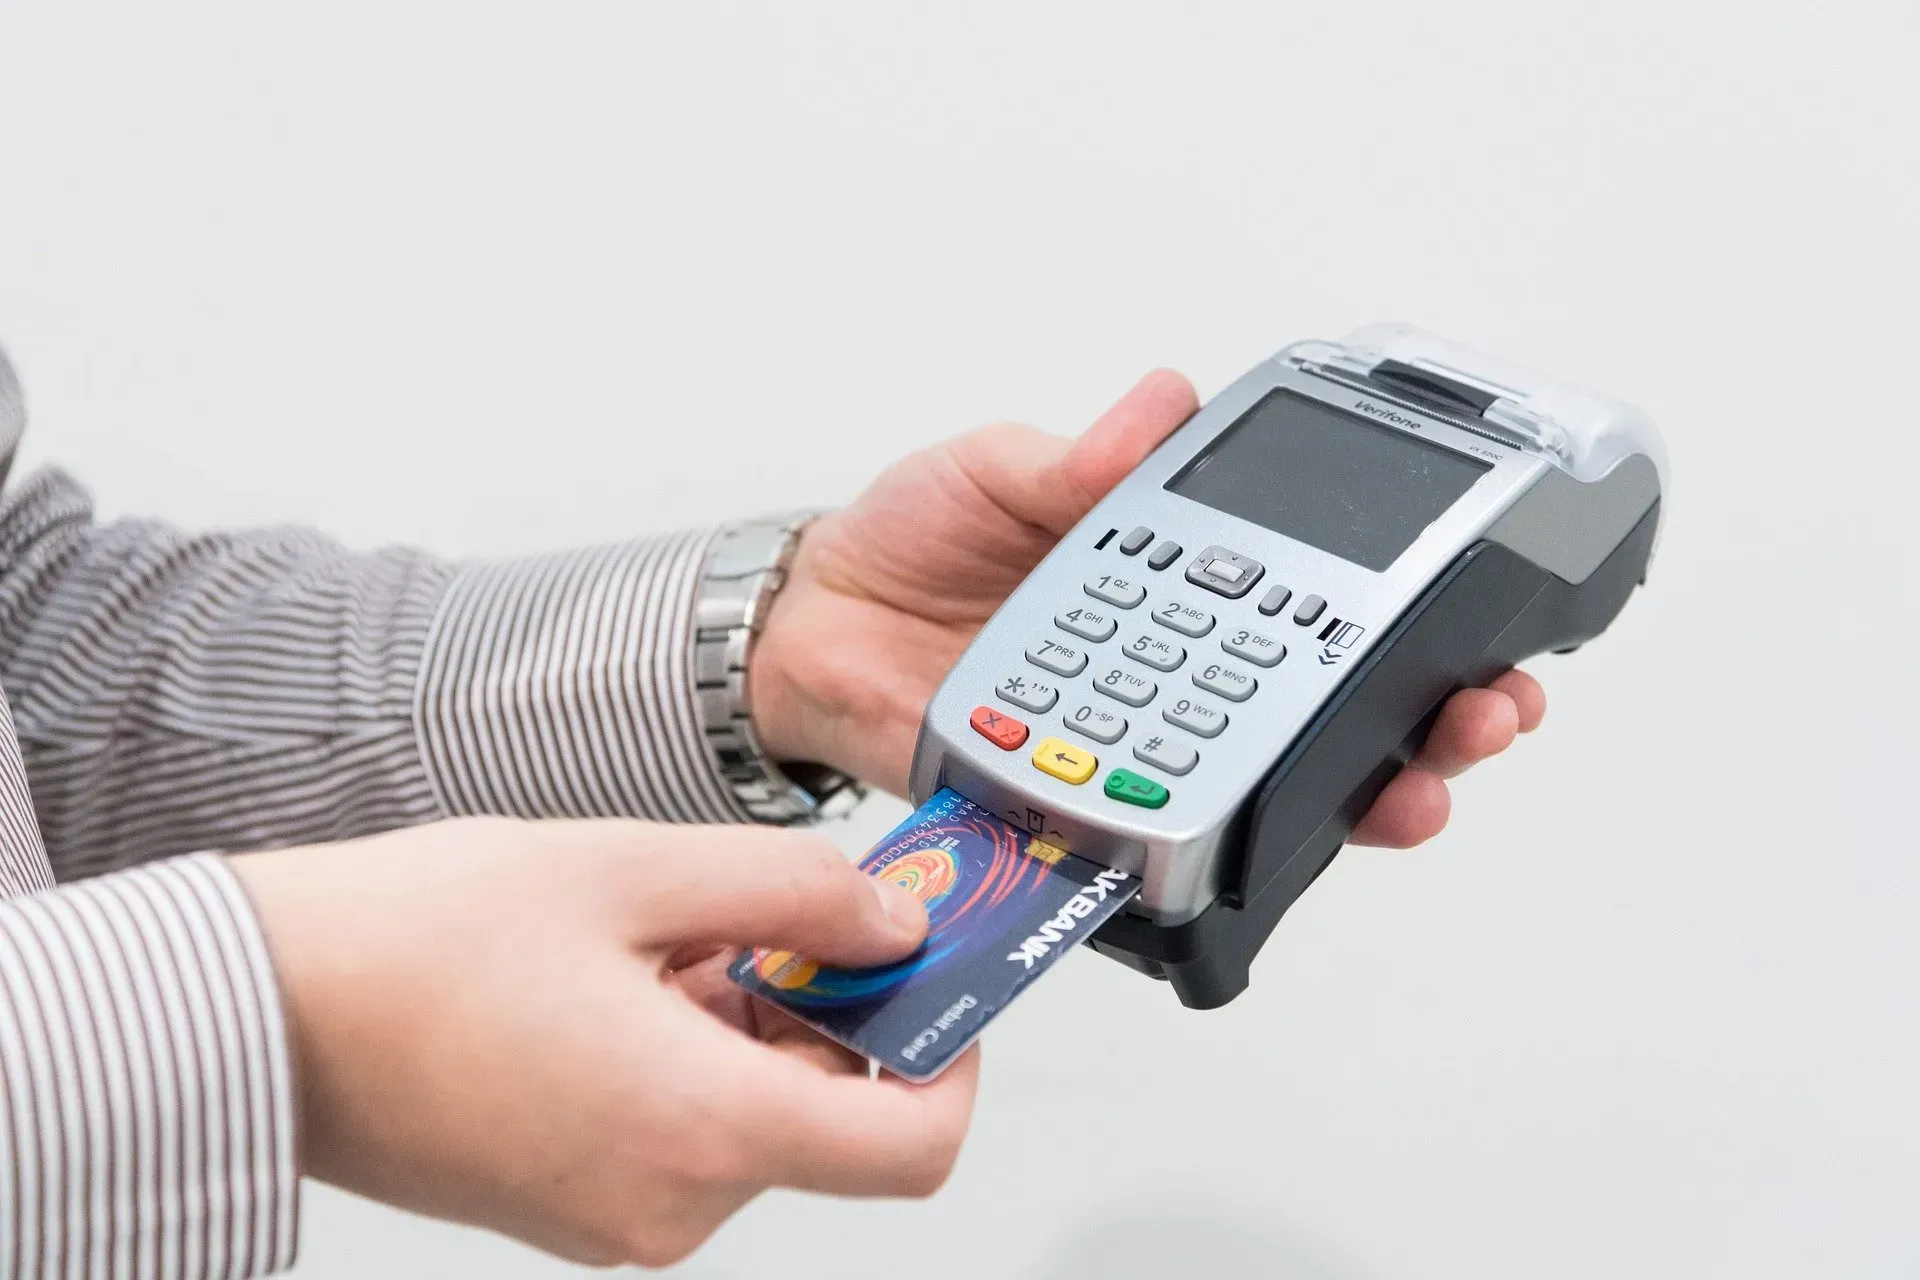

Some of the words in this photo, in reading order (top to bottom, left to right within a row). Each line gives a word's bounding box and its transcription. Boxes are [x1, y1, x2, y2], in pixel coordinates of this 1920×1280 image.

[1354, 400, 1422, 430] Verifone
[1098, 575, 1112, 589] 1
[1065, 608, 1083, 623] 4
[1084, 612, 1104, 624] GHI
[1161, 602, 1181, 618] 2
[1181, 607, 1204, 620] ABC
[1132, 635, 1152, 651] 5
[1152, 641, 1171, 653] JKL
[1231, 630, 1250, 646] 3
[1252, 636, 1274, 648] DEF
[1037, 639, 1056, 655] 7
[1054, 645, 1075, 659] PRS
[1104, 669, 1123, 685] 8
[1124, 674, 1146, 687] TUV
[1203, 664, 1221, 680] 6
[1222, 669, 1247, 684] MNO
[1075, 706, 1092, 721] 0
[1172, 700, 1190, 715] 9
[1193, 704, 1217, 718] WXY
[1144, 736, 1163, 752] #
[1006, 868, 1130, 969] AKBANK
[932, 993, 978, 1032] Debit
[901, 1027, 939, 1062] Card
